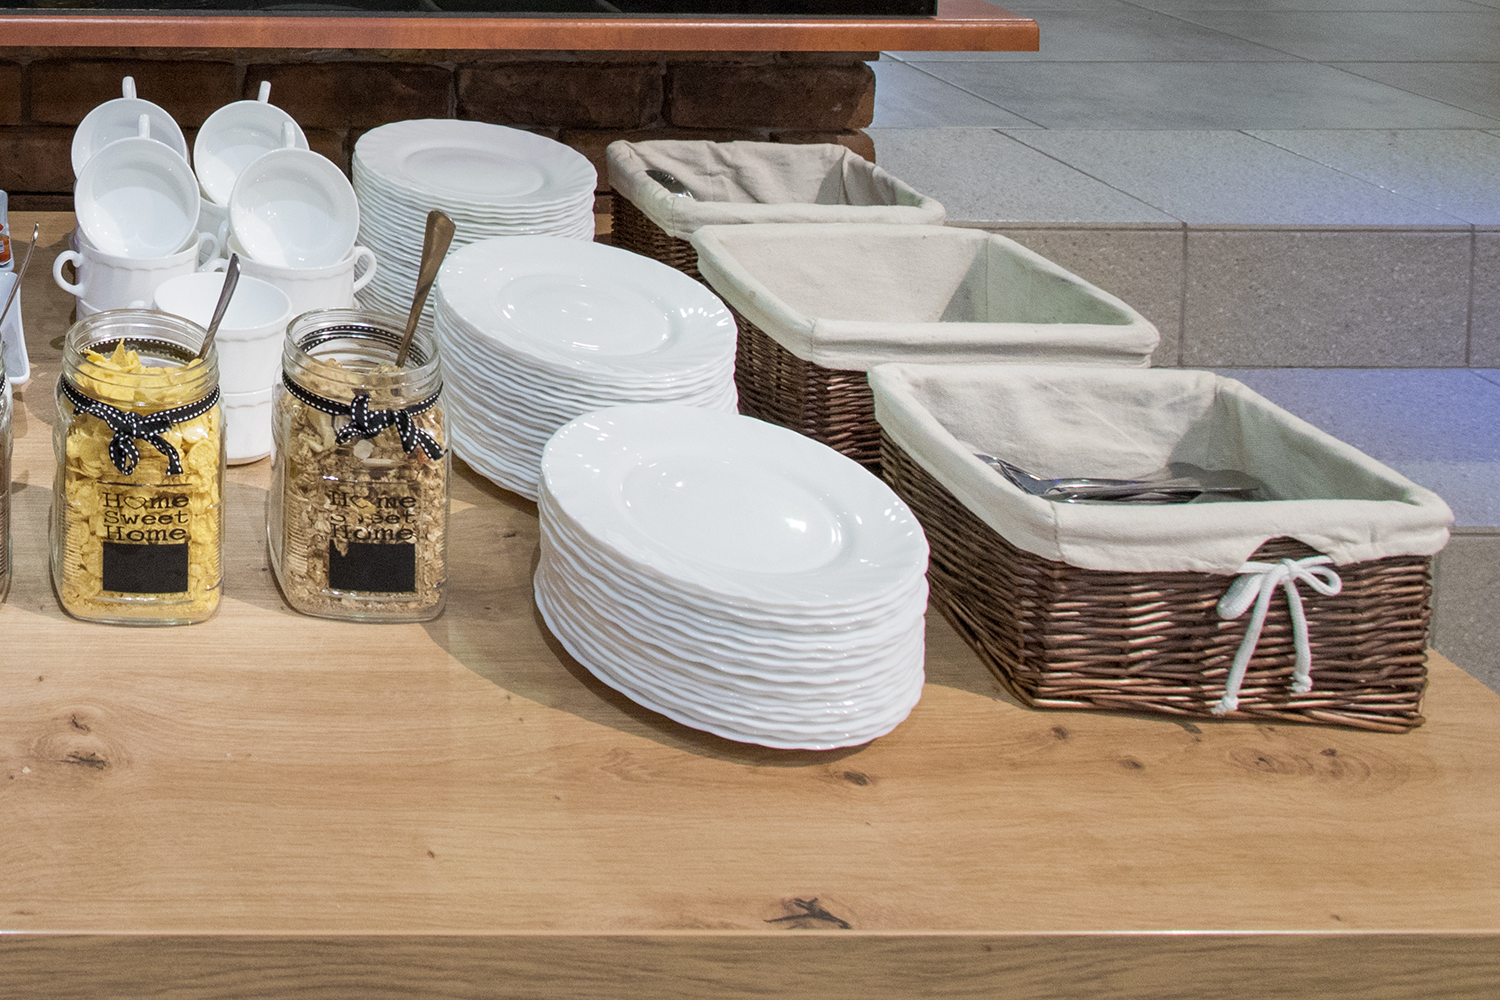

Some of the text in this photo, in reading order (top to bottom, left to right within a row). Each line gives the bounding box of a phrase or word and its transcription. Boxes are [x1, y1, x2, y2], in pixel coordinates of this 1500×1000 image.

[104, 511, 189, 525] Sweet
[330, 511, 416, 525] Seet
[104, 525, 187, 541] Home
[331, 525, 415, 541] Home
